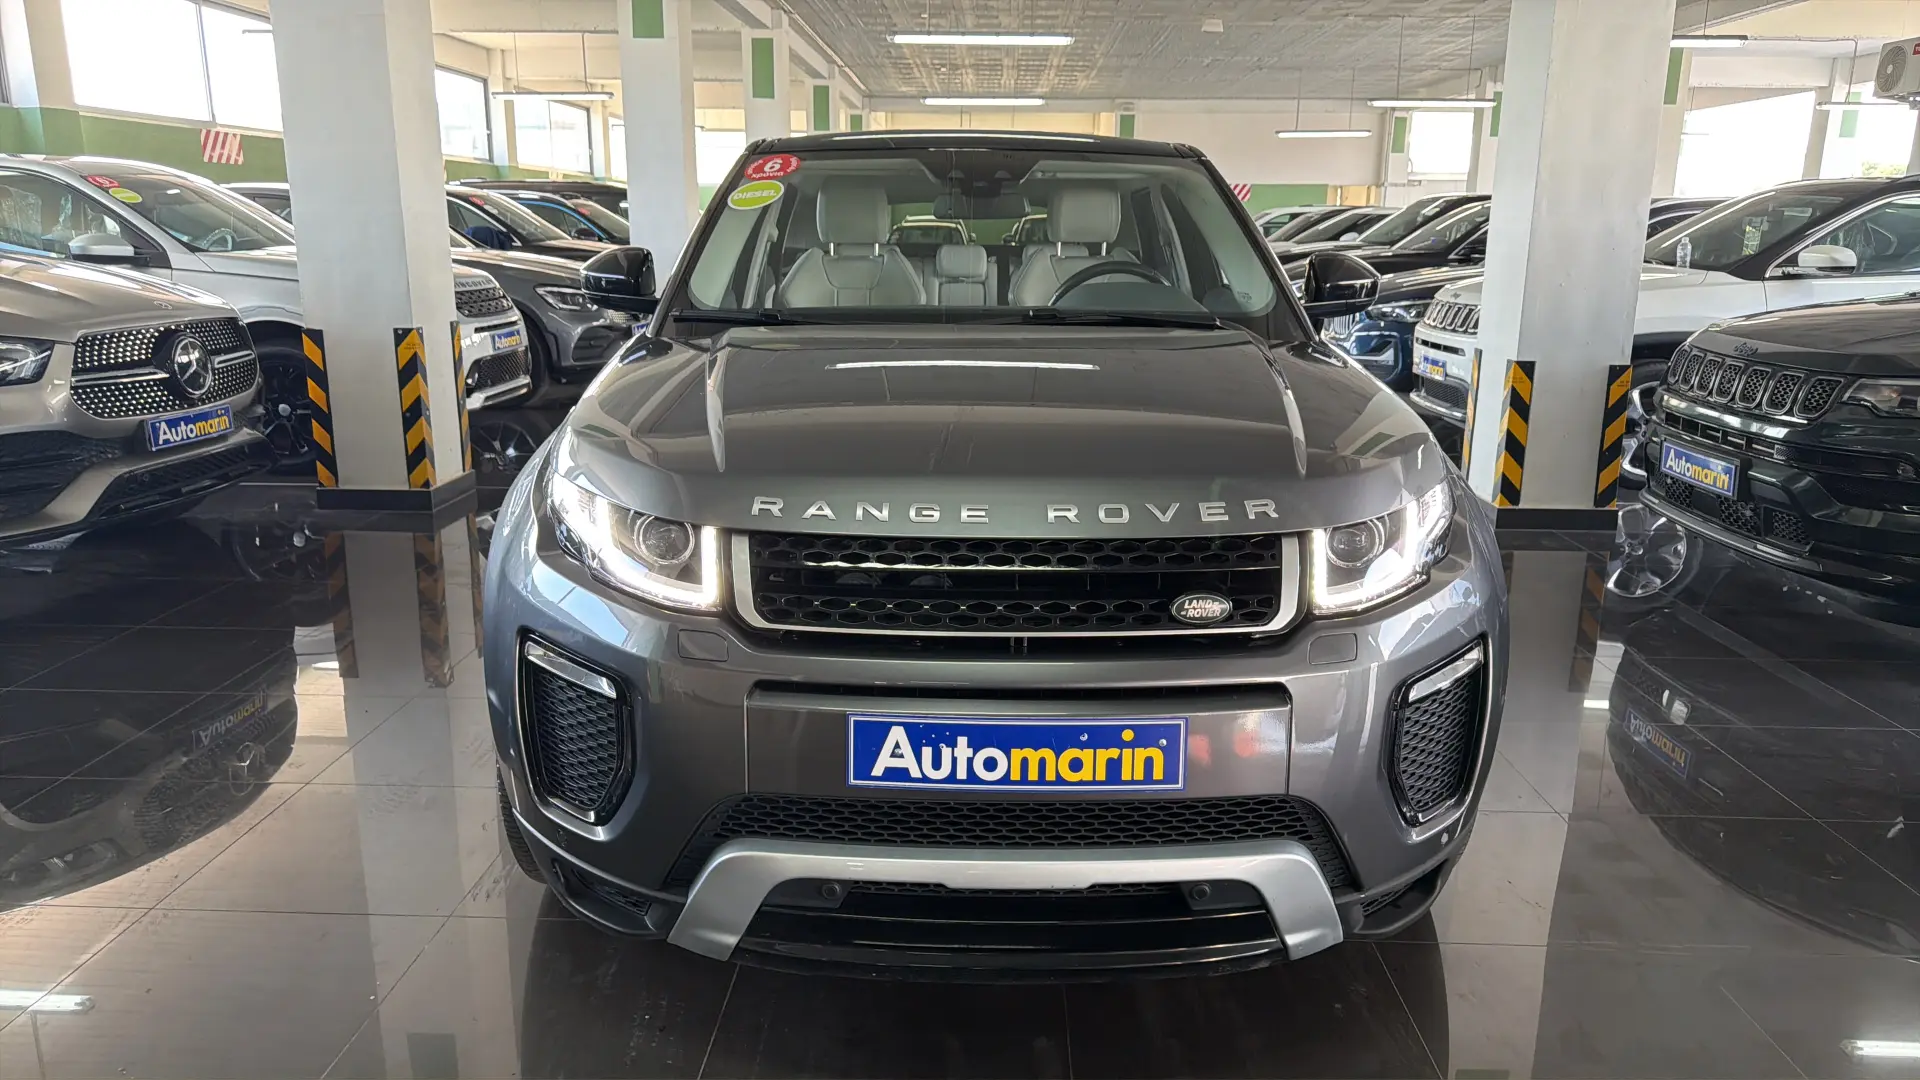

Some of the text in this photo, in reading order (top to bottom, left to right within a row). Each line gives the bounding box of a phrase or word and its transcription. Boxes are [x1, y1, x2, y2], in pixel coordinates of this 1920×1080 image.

[764, 160, 782, 172] 6
[733, 189, 777, 200] DIESEL
[158, 409, 230, 445] Automarin
[1665, 448, 1730, 491] Automarin
[750, 495, 1281, 525] RANGE ROVER
[1183, 599, 1213, 609] LAND
[1186, 608, 1222, 618] ROVER
[870, 724, 1165, 783] Automarin
